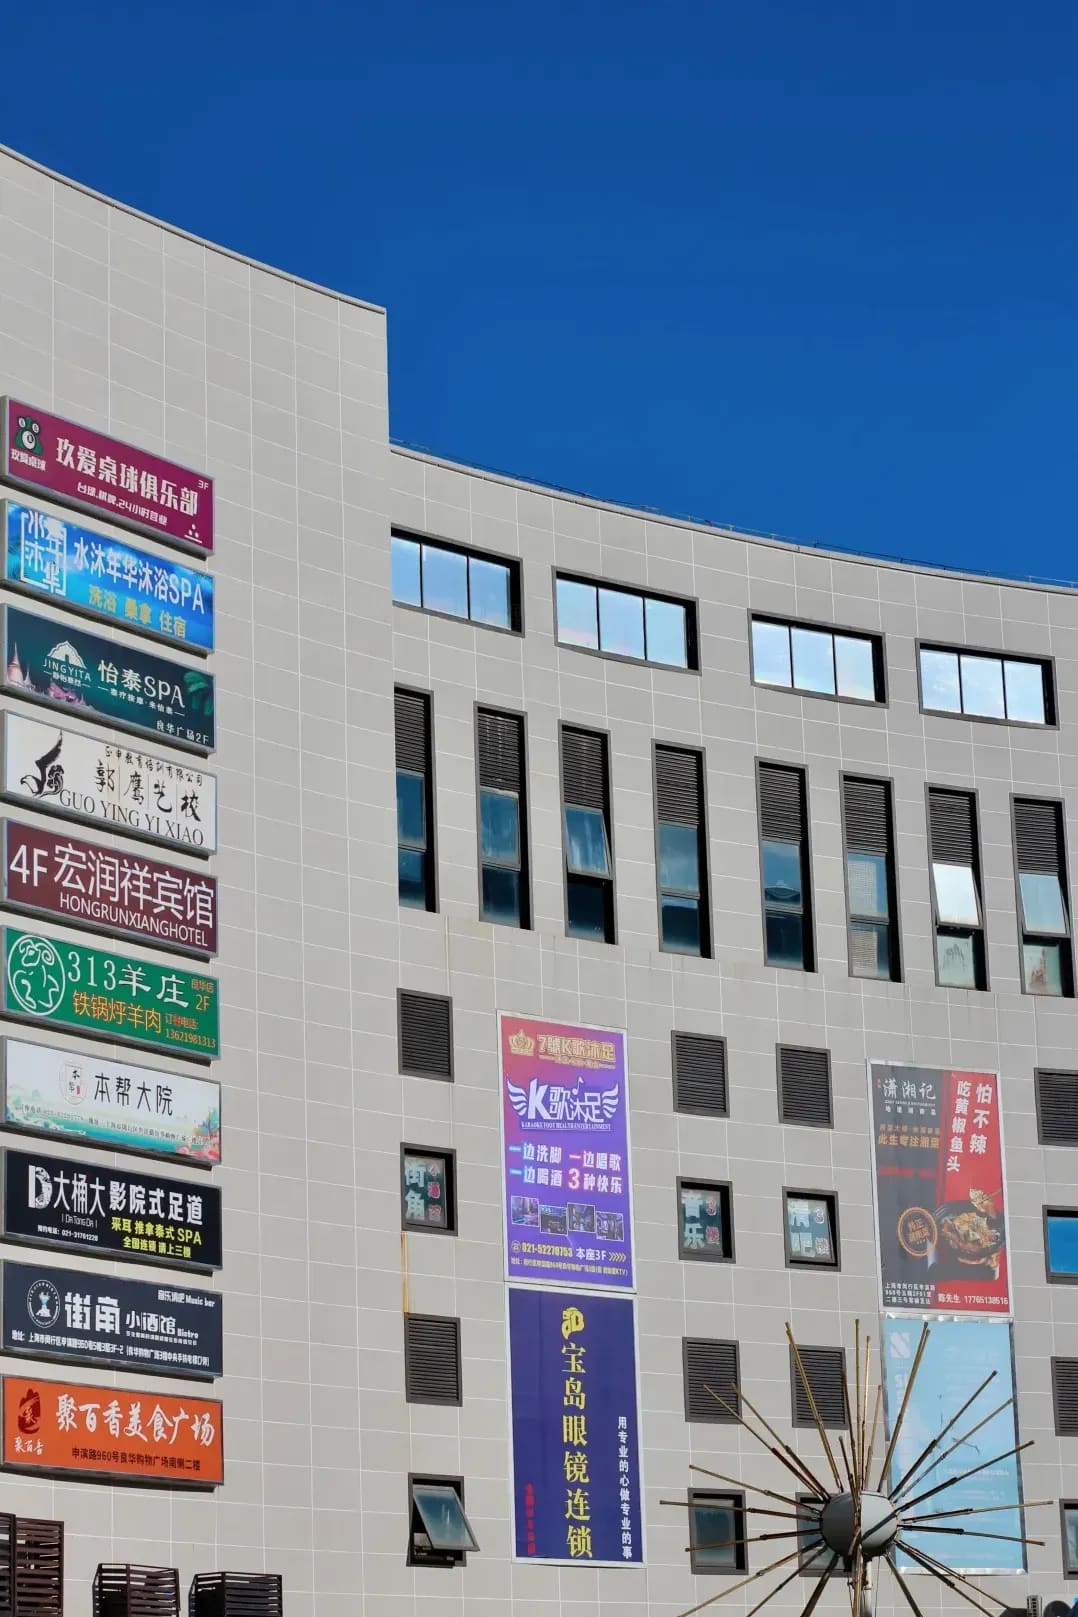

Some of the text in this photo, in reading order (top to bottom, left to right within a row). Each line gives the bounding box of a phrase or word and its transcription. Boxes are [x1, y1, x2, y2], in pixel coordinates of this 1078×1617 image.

[56, 437, 198, 517] 玖爱桌球俱乐部
[198, 480, 209, 491] 3F
[59, 788, 204, 846] GUO YING YI XIAO
[9, 843, 215, 929] 4F 宏润祥宾馆
[59, 891, 209, 948] HONGRUNXIANGHOTEL
[195, 994, 211, 1013] 2F
[94, 1071, 174, 1117] 本帮大院
[109, 1180, 204, 1226] 影院式足道
[177, 1227, 203, 1246] SPA
[55, 1392, 216, 1447] 聚百香美食广场
[561, 1342, 593, 1559] 宝岛眼镜连锁
[617, 1416, 633, 1559] 用专业的心做专业的事
